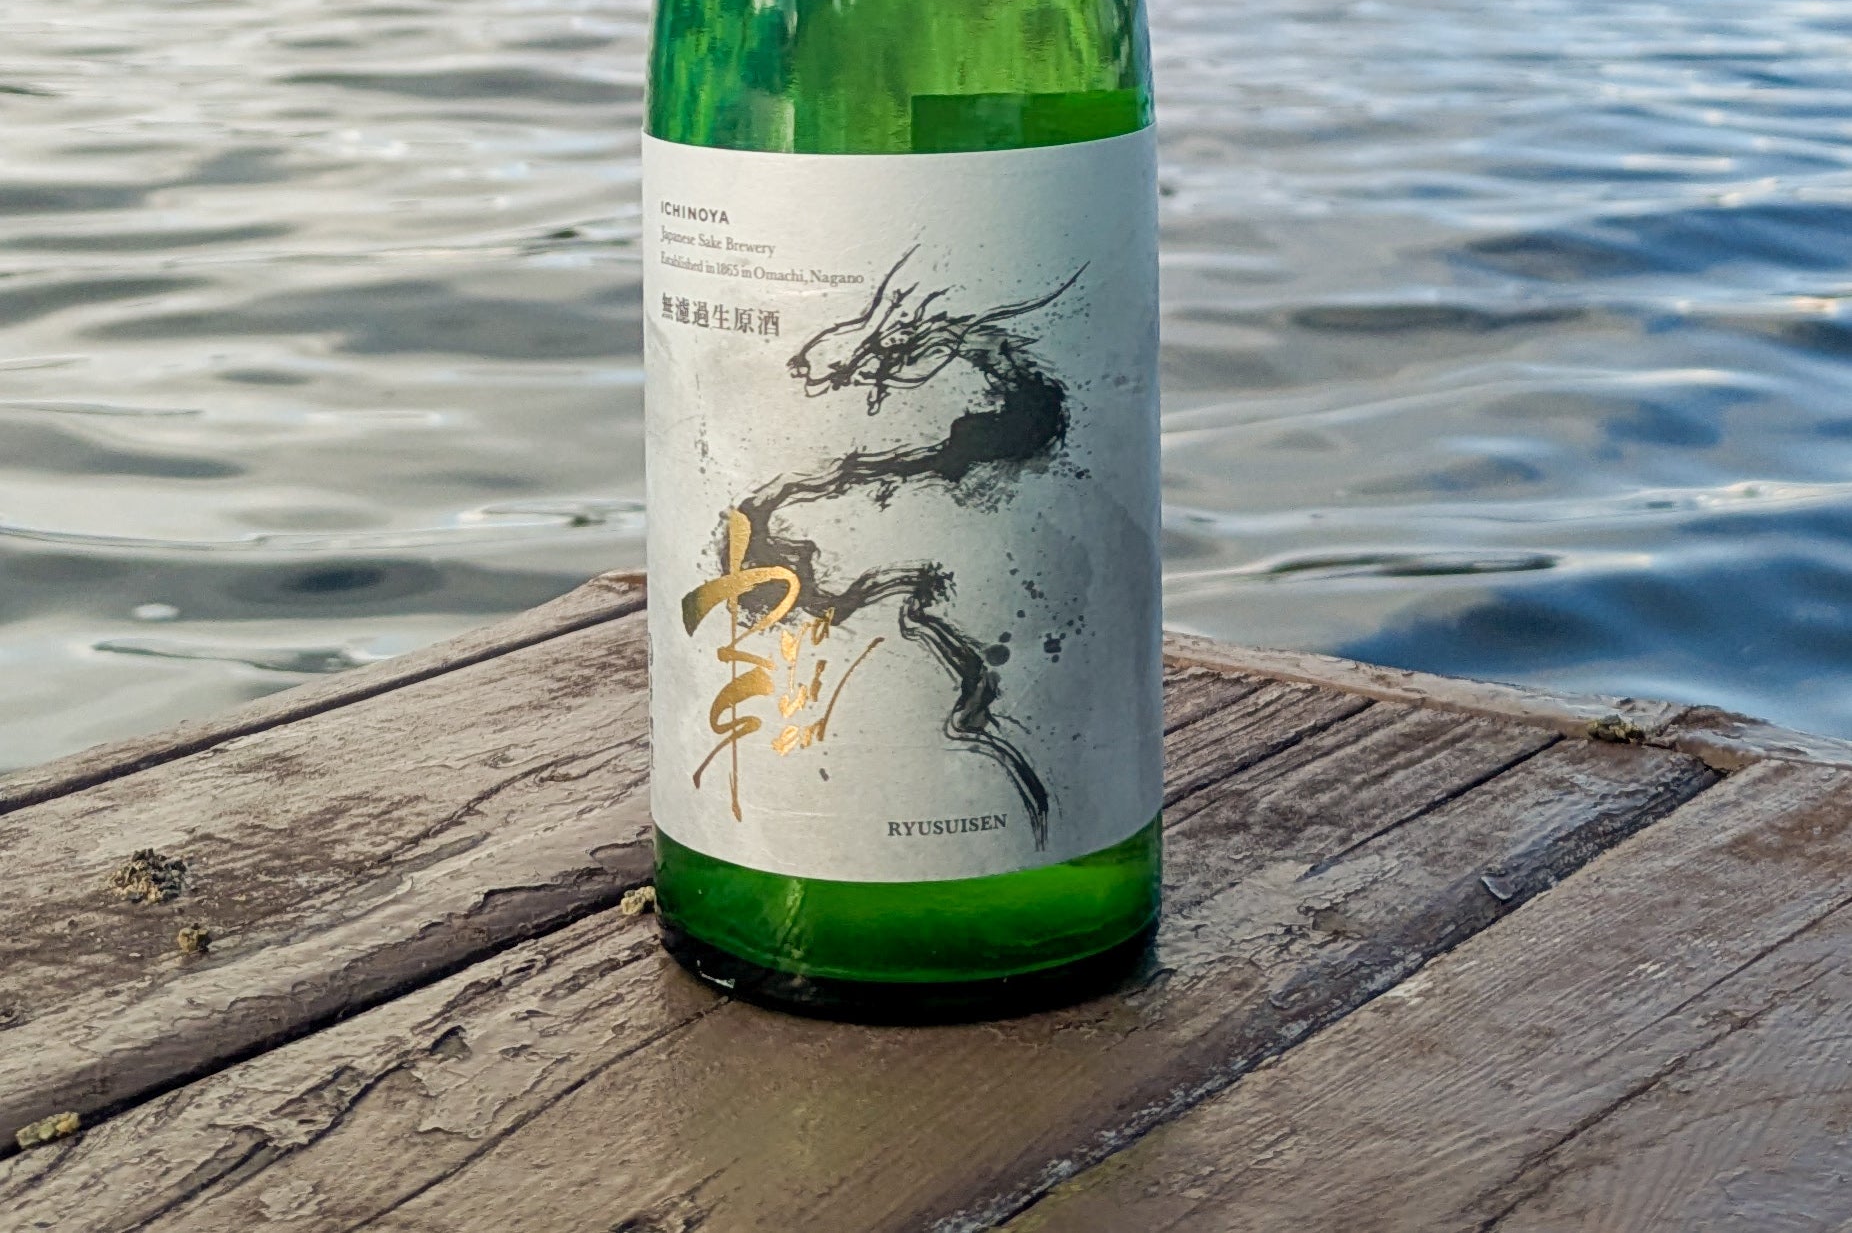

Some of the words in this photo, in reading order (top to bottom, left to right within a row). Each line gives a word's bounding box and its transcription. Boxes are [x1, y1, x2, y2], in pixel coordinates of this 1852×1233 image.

[660, 200, 730, 225] ICHINOYA
[660, 225, 696, 245] Japanese
[698, 233, 722, 250] Sake
[725, 236, 776, 258] Brewery
[661, 250, 704, 272] Established
[705, 260, 716, 275] in
[716, 262, 740, 277] 1865
[741, 264, 752, 279] in
[754, 266, 808, 285] Omachi,
[809, 269, 865, 287] Nagano
[661, 292, 781, 337] 無濾過生原酒
[887, 813, 1008, 837] RYUSUISEN
